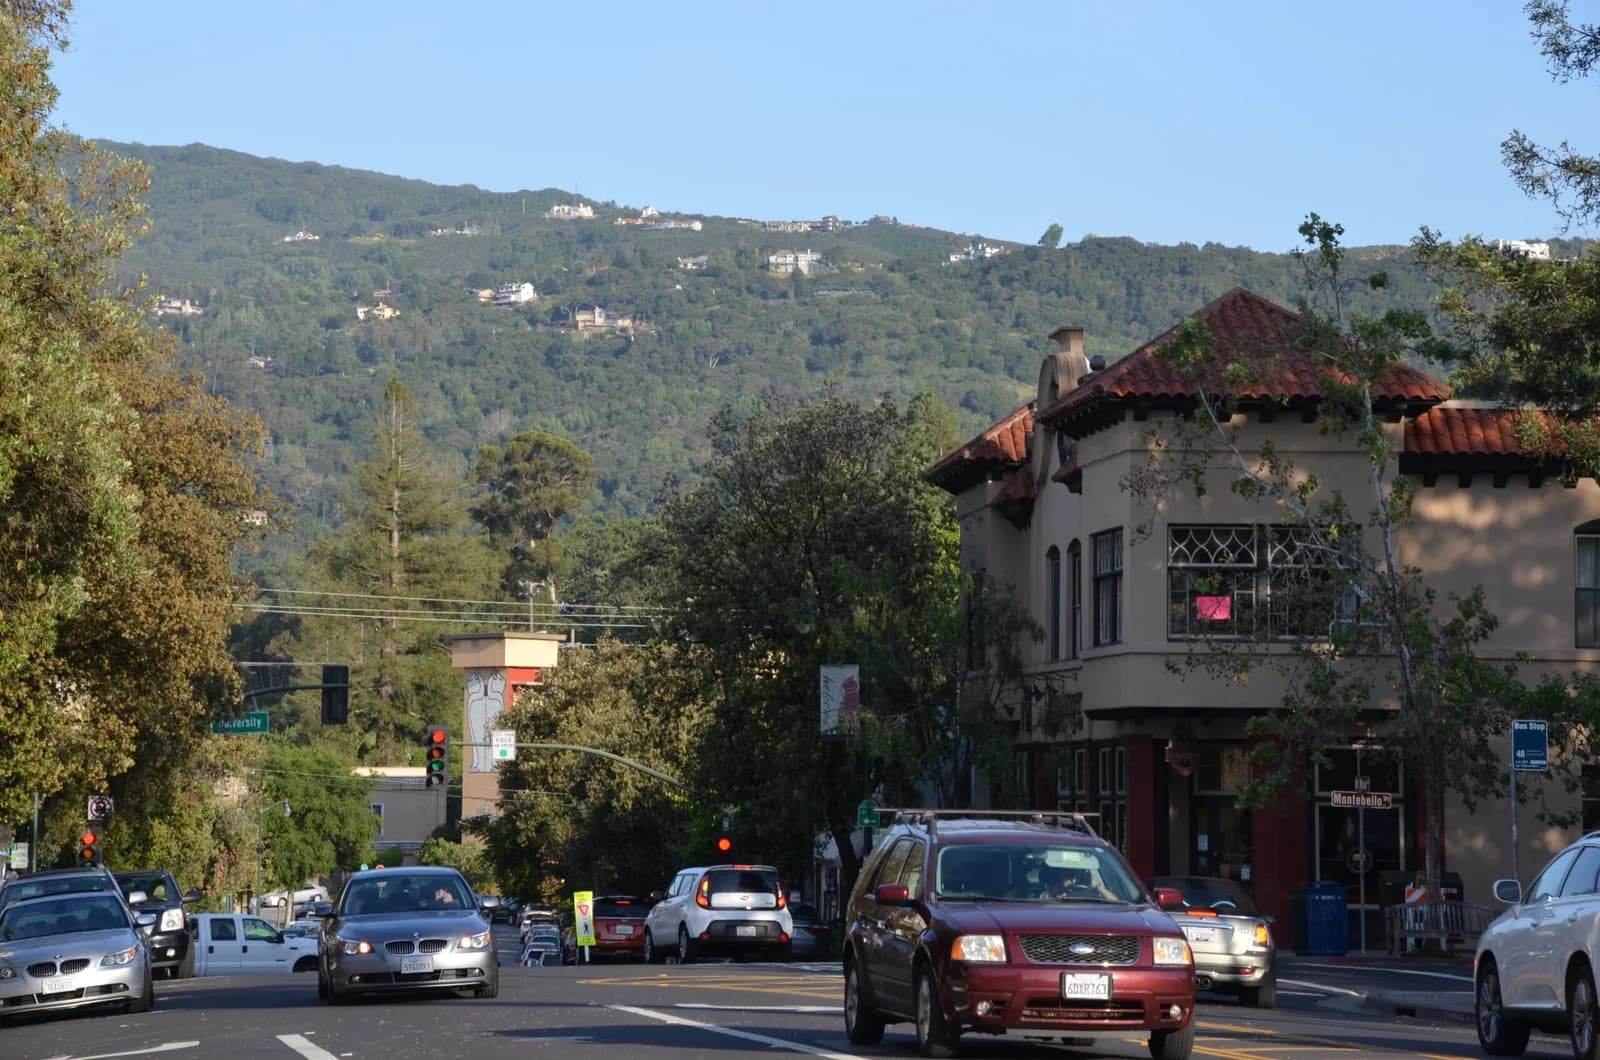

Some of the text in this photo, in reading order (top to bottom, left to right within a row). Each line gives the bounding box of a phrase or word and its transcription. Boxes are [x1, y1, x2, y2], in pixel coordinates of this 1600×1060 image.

[1514, 722, 1546, 731] Bus Stop
[1333, 793, 1382, 806] Montebello
[1067, 983, 1107, 995] 6DXR763
